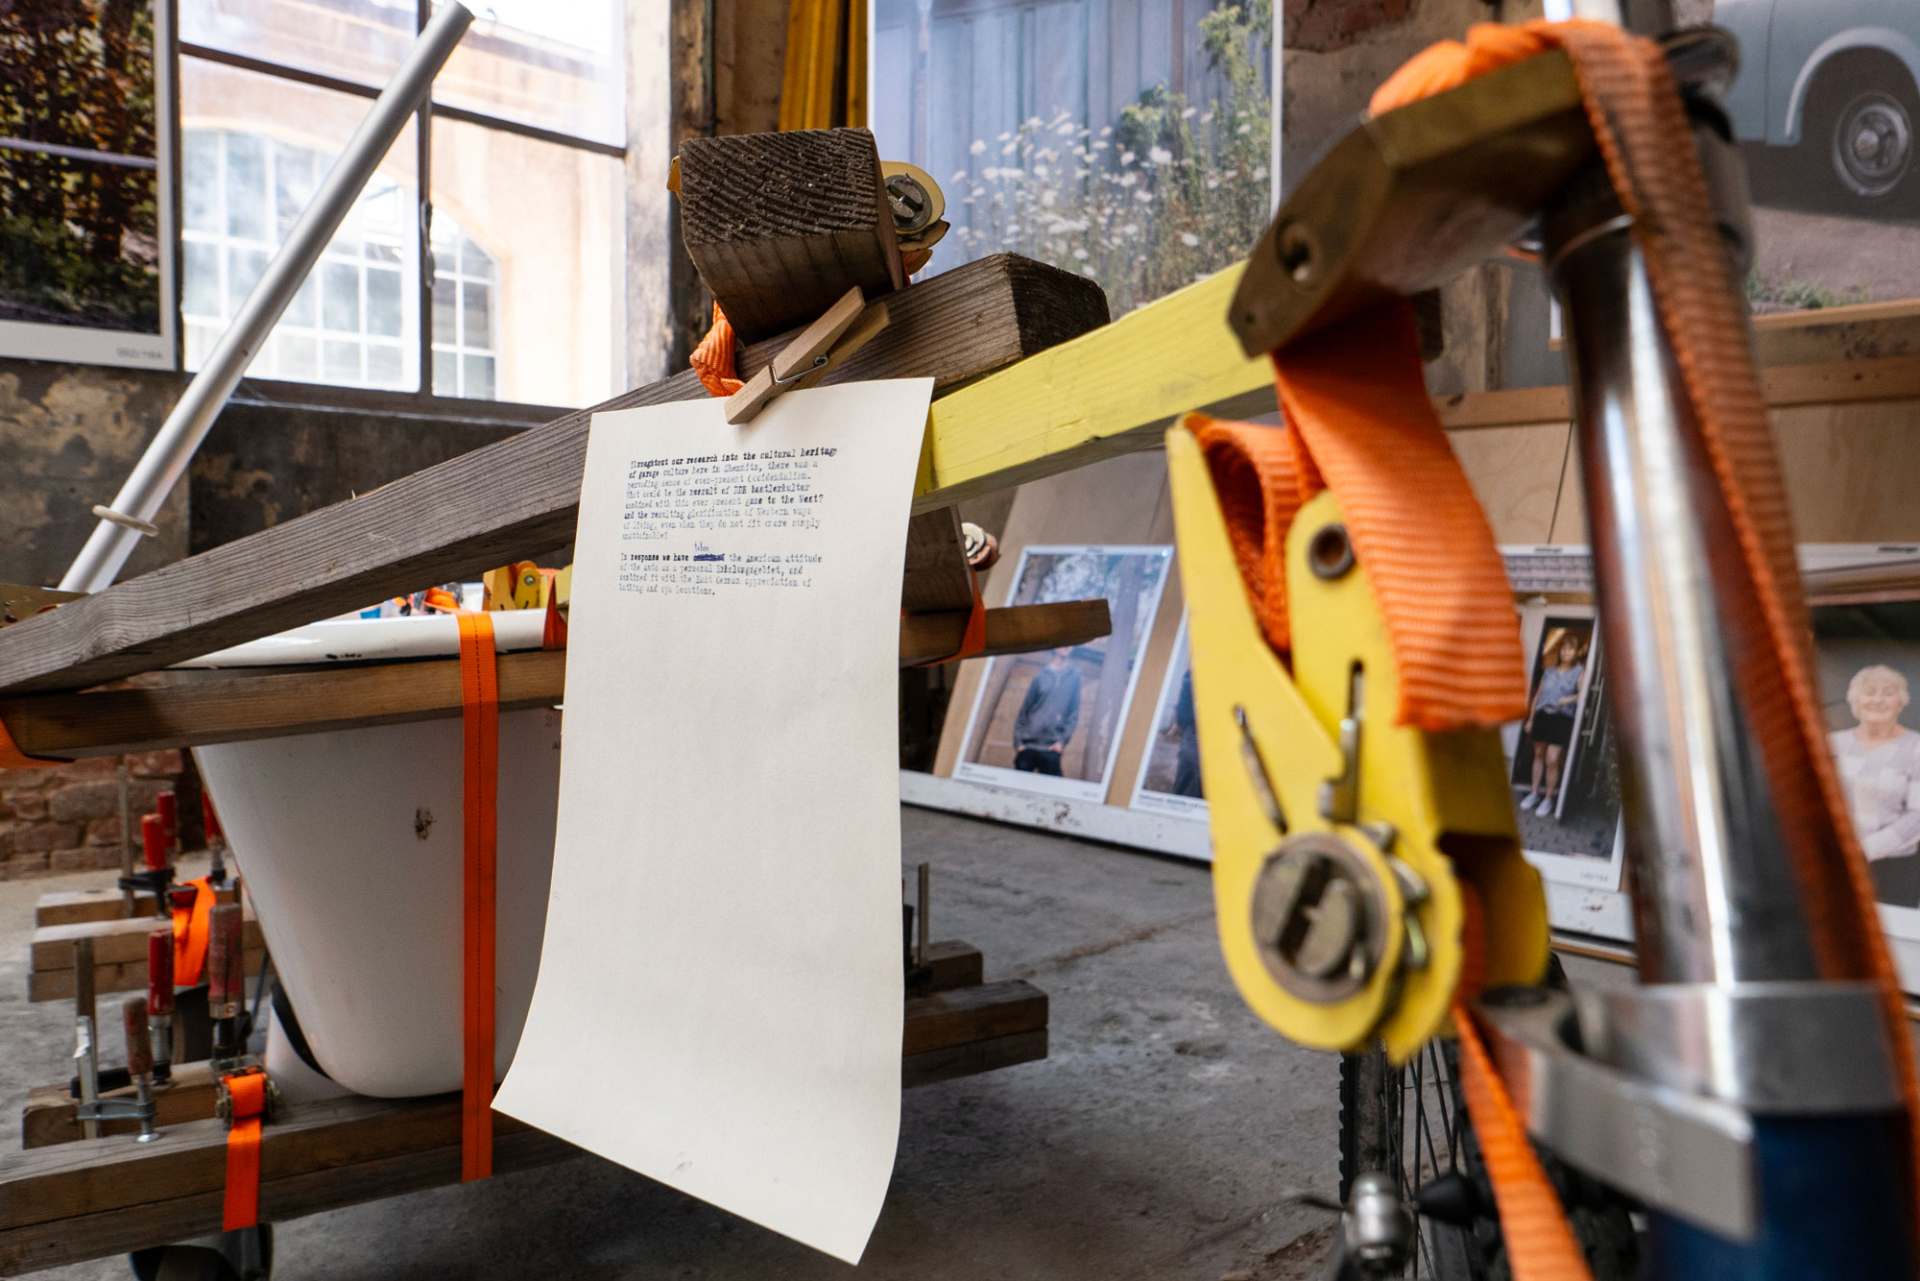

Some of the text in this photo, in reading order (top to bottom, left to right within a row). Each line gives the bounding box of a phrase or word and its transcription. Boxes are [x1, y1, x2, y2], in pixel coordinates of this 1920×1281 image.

[672, 456, 684, 464] our
[686, 454, 718, 464] research
[722, 452, 738, 461] into
[743, 451, 756, 460] the
[760, 449, 795, 458] cultural
[629, 470, 637, 478] of
[639, 470, 659, 479] garage
[663, 467, 689, 476] culture
[692, 466, 708, 474] here
[712, 465, 720, 473] in
[768, 461, 789, 470] there
[684, 477, 691, 485] of
[664, 488, 672, 497] be
[676, 488, 686, 496] the
[722, 486, 730, 494] of
[734, 485, 747, 494] DDR
[656, 499, 670, 508] with
[693, 499, 707, 507] ever
[624, 511, 635, 519] and
[638, 510, 648, 519] the
[745, 508, 754, 516] of
[718, 519, 727, 528] do
[630, 554, 659, 562] response
[729, 553, 741, 562] the
[786, 554, 822, 563] attitude
[630, 563, 641, 571] the
[789, 566, 803, 574] and
[803, 579, 812, 587] of
